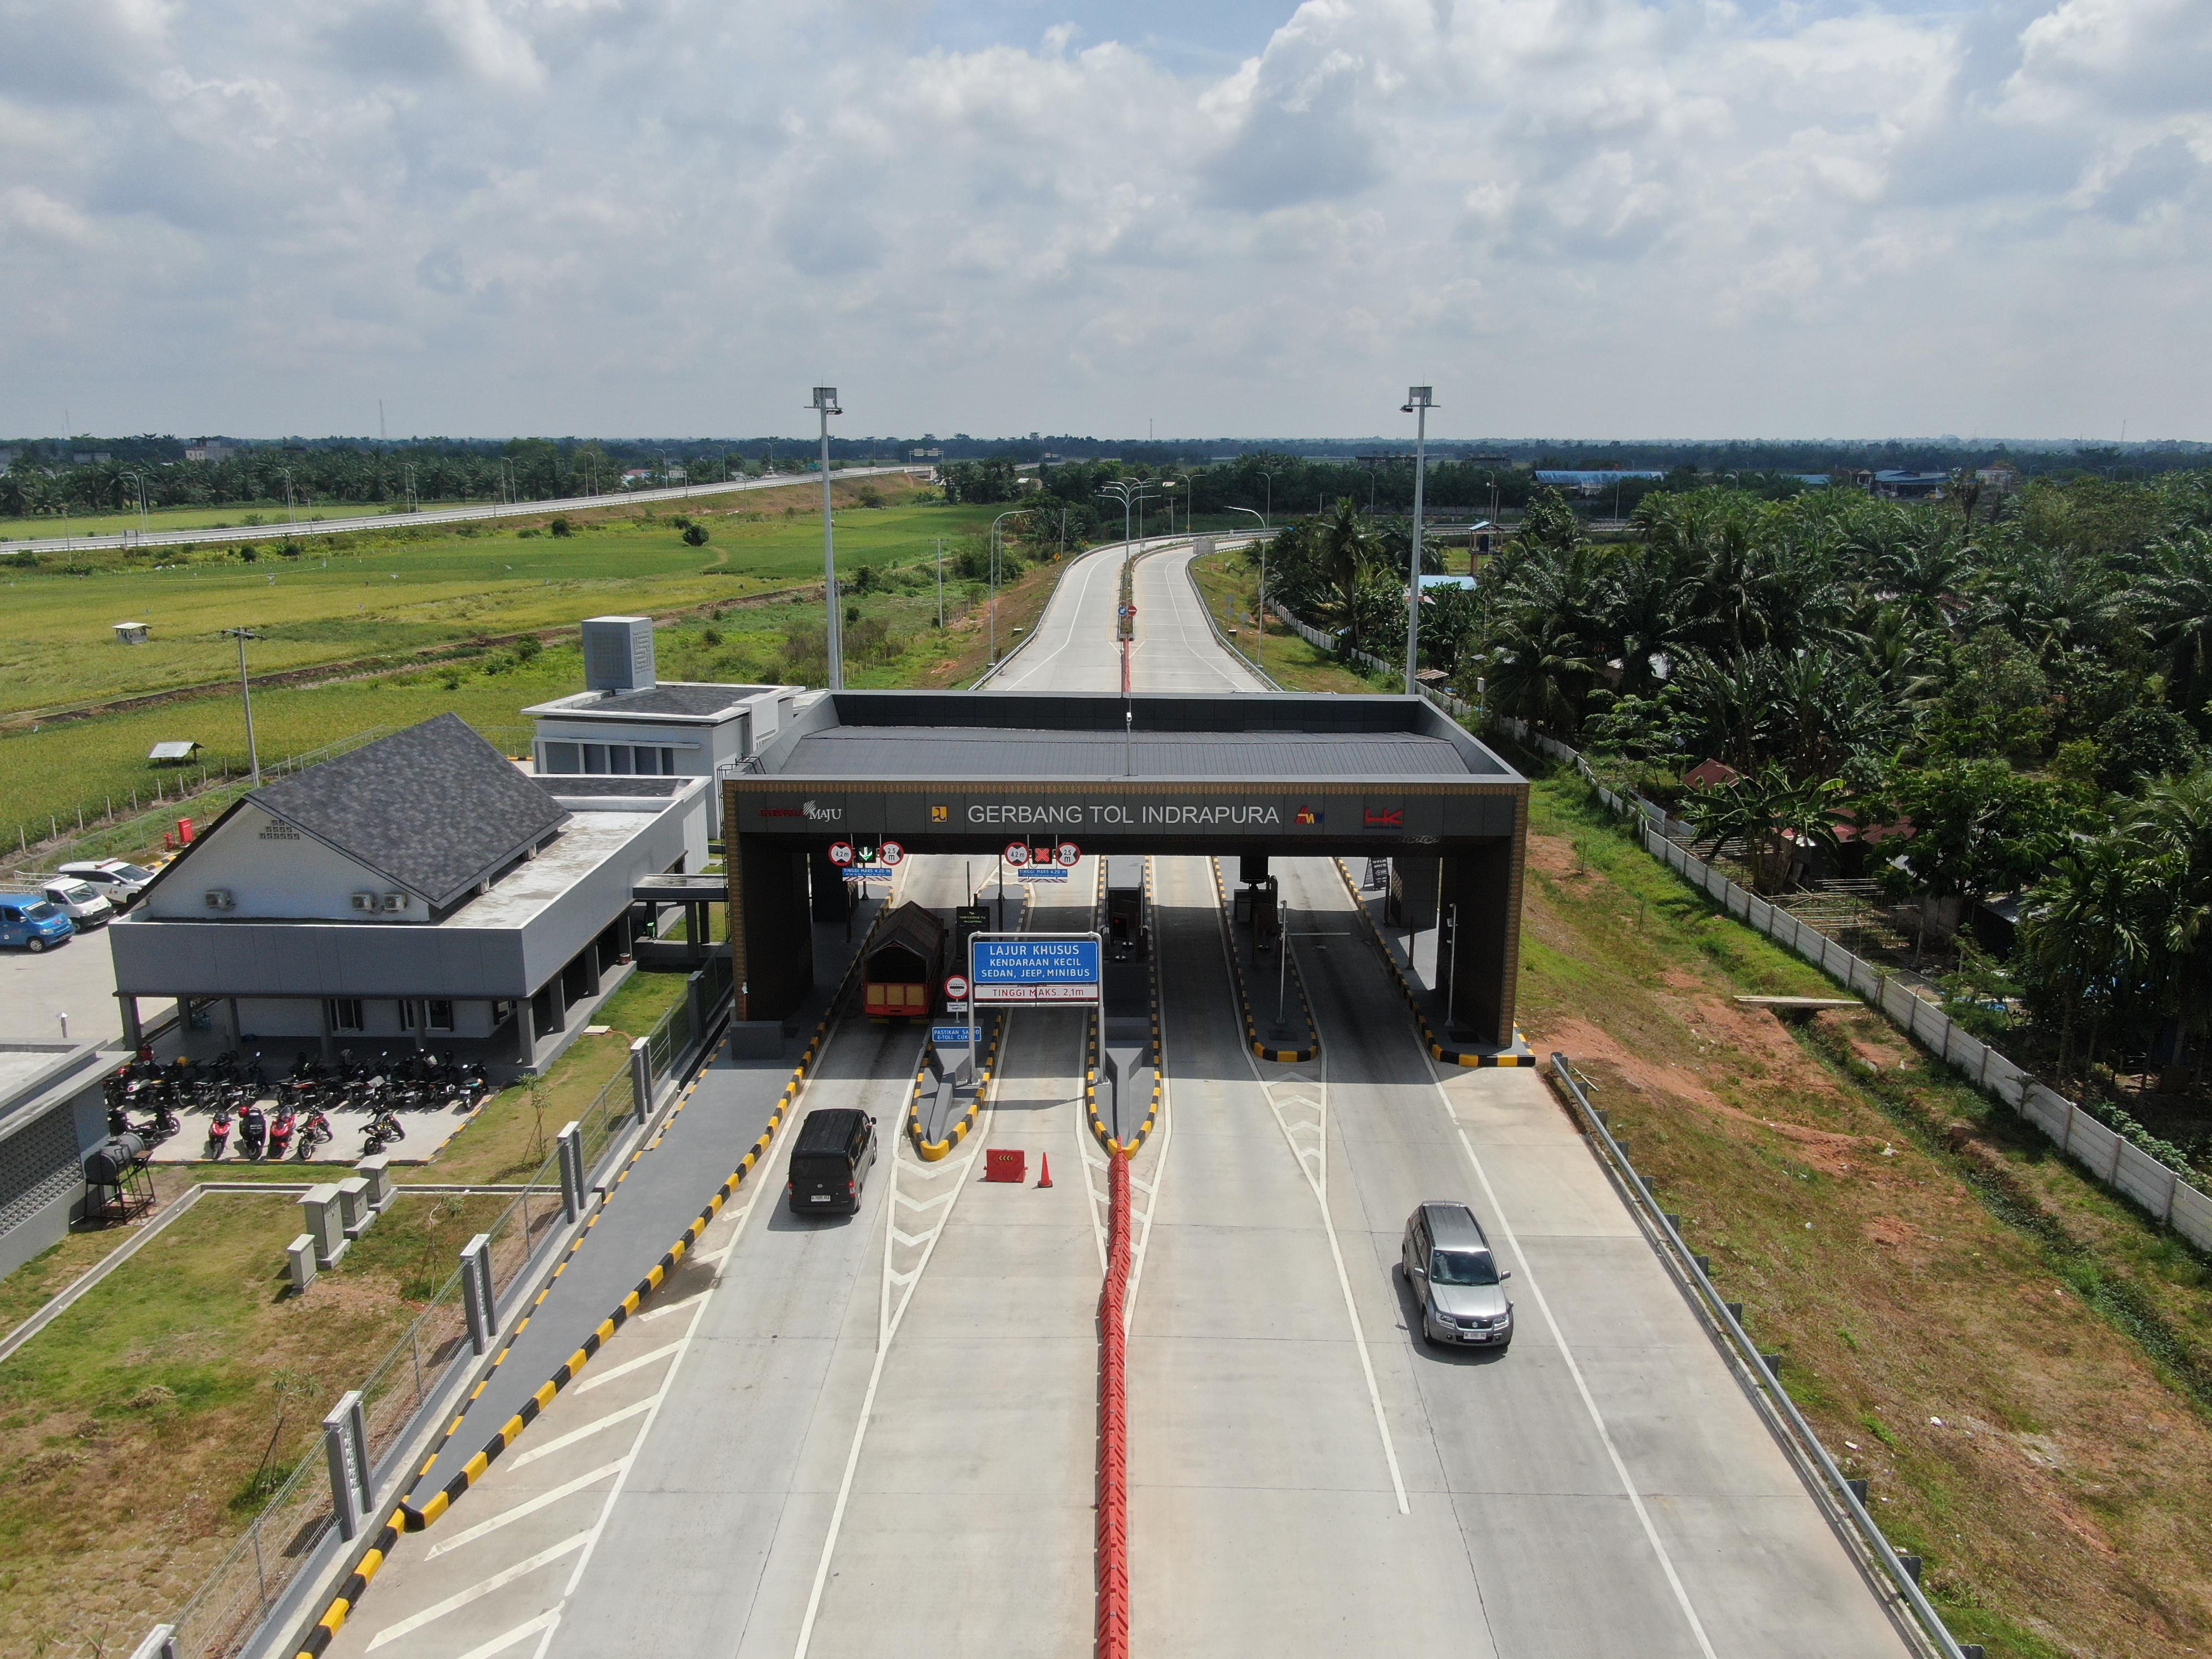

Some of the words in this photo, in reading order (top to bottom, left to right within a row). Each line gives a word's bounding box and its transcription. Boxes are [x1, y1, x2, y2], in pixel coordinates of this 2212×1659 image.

[810, 808, 842, 822] MAJU
[968, 805, 1082, 823] GERBANG
[1089, 806, 1134, 823] TOL
[1142, 806, 1280, 823] INDRAPURA
[989, 946, 1026, 956] LAJUR
[1033, 945, 1079, 955] KHUSUS
[990, 958, 1049, 967] KENDARAAN
[1054, 958, 1081, 966] KECIL
[982, 970, 1016, 978] SEDAN,
[1021, 970, 1045, 978] JEEP,
[993, 989, 1025, 997] TINGGI
[1029, 988, 1060, 997] MAKS.
